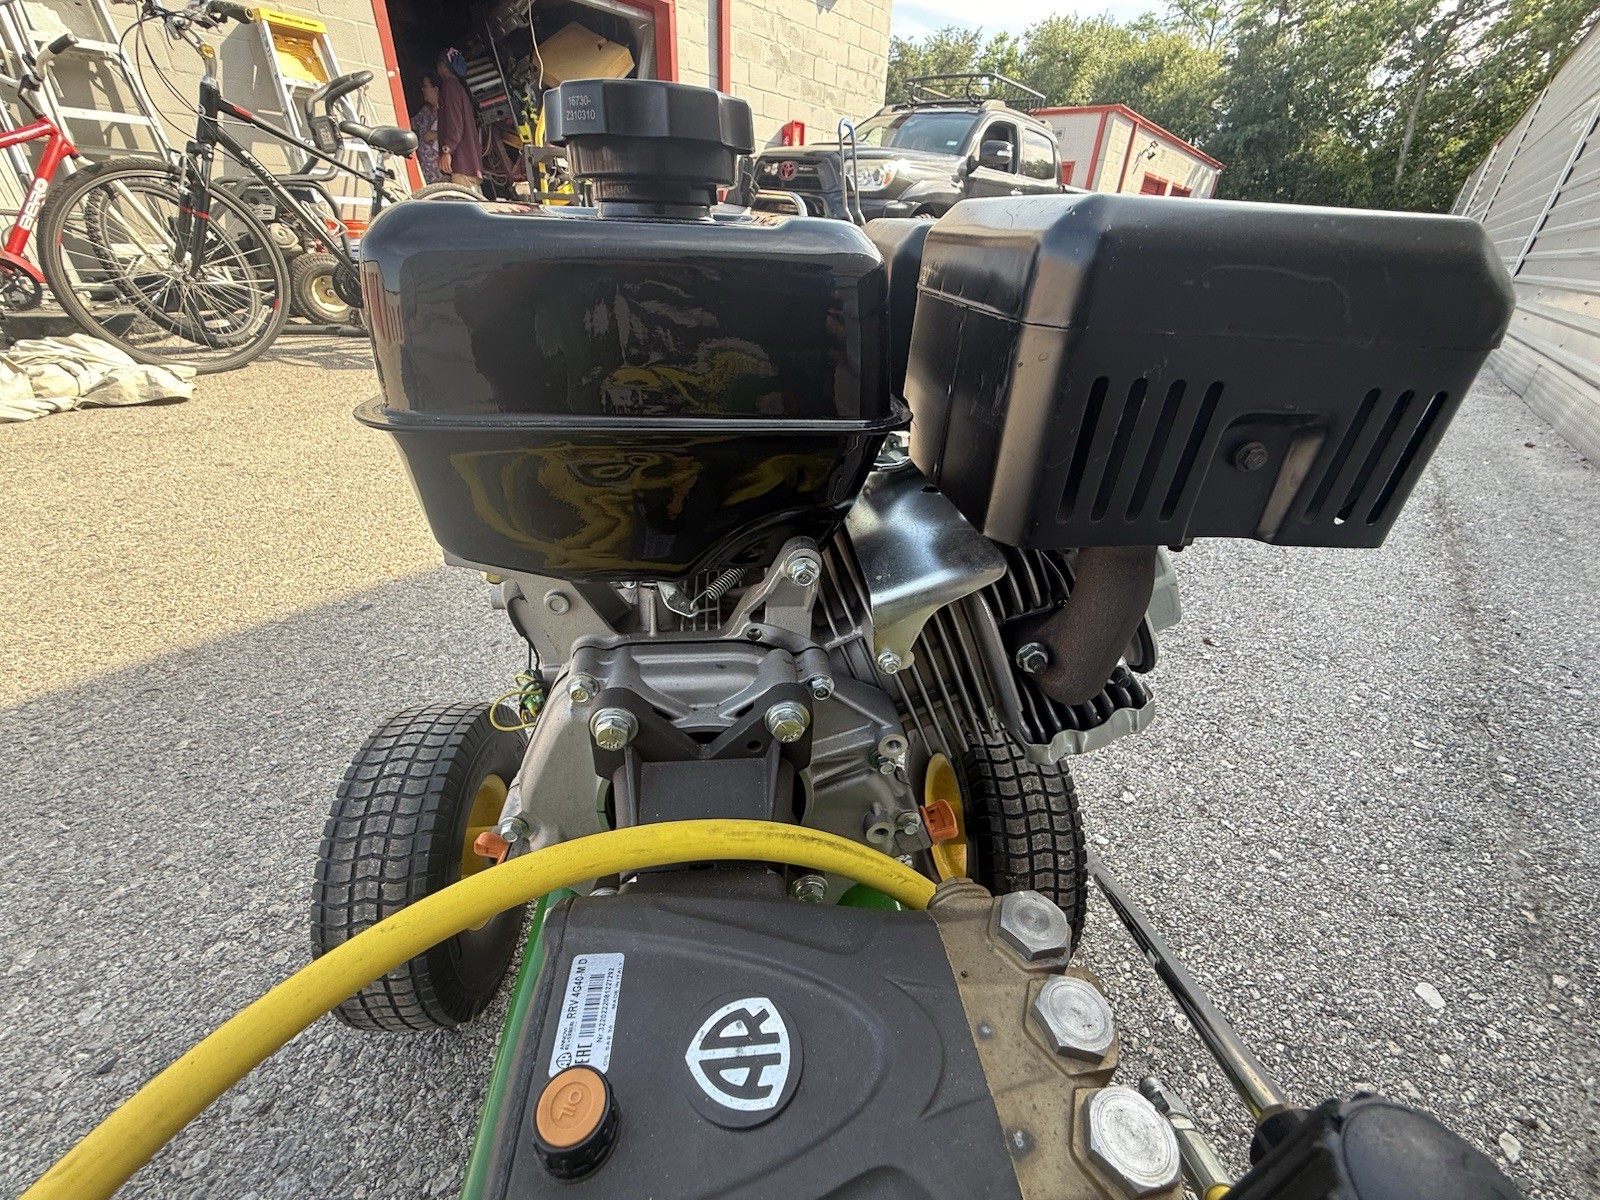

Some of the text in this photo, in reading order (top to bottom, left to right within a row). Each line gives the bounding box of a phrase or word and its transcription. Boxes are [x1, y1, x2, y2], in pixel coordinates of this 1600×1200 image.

[568, 94, 592, 106] 16730-
[565, 109, 596, 121] Z310310
[567, 1000, 578, 1019] RRV
[698, 1006, 781, 1100] AR
[557, 1091, 582, 1120] OIL
